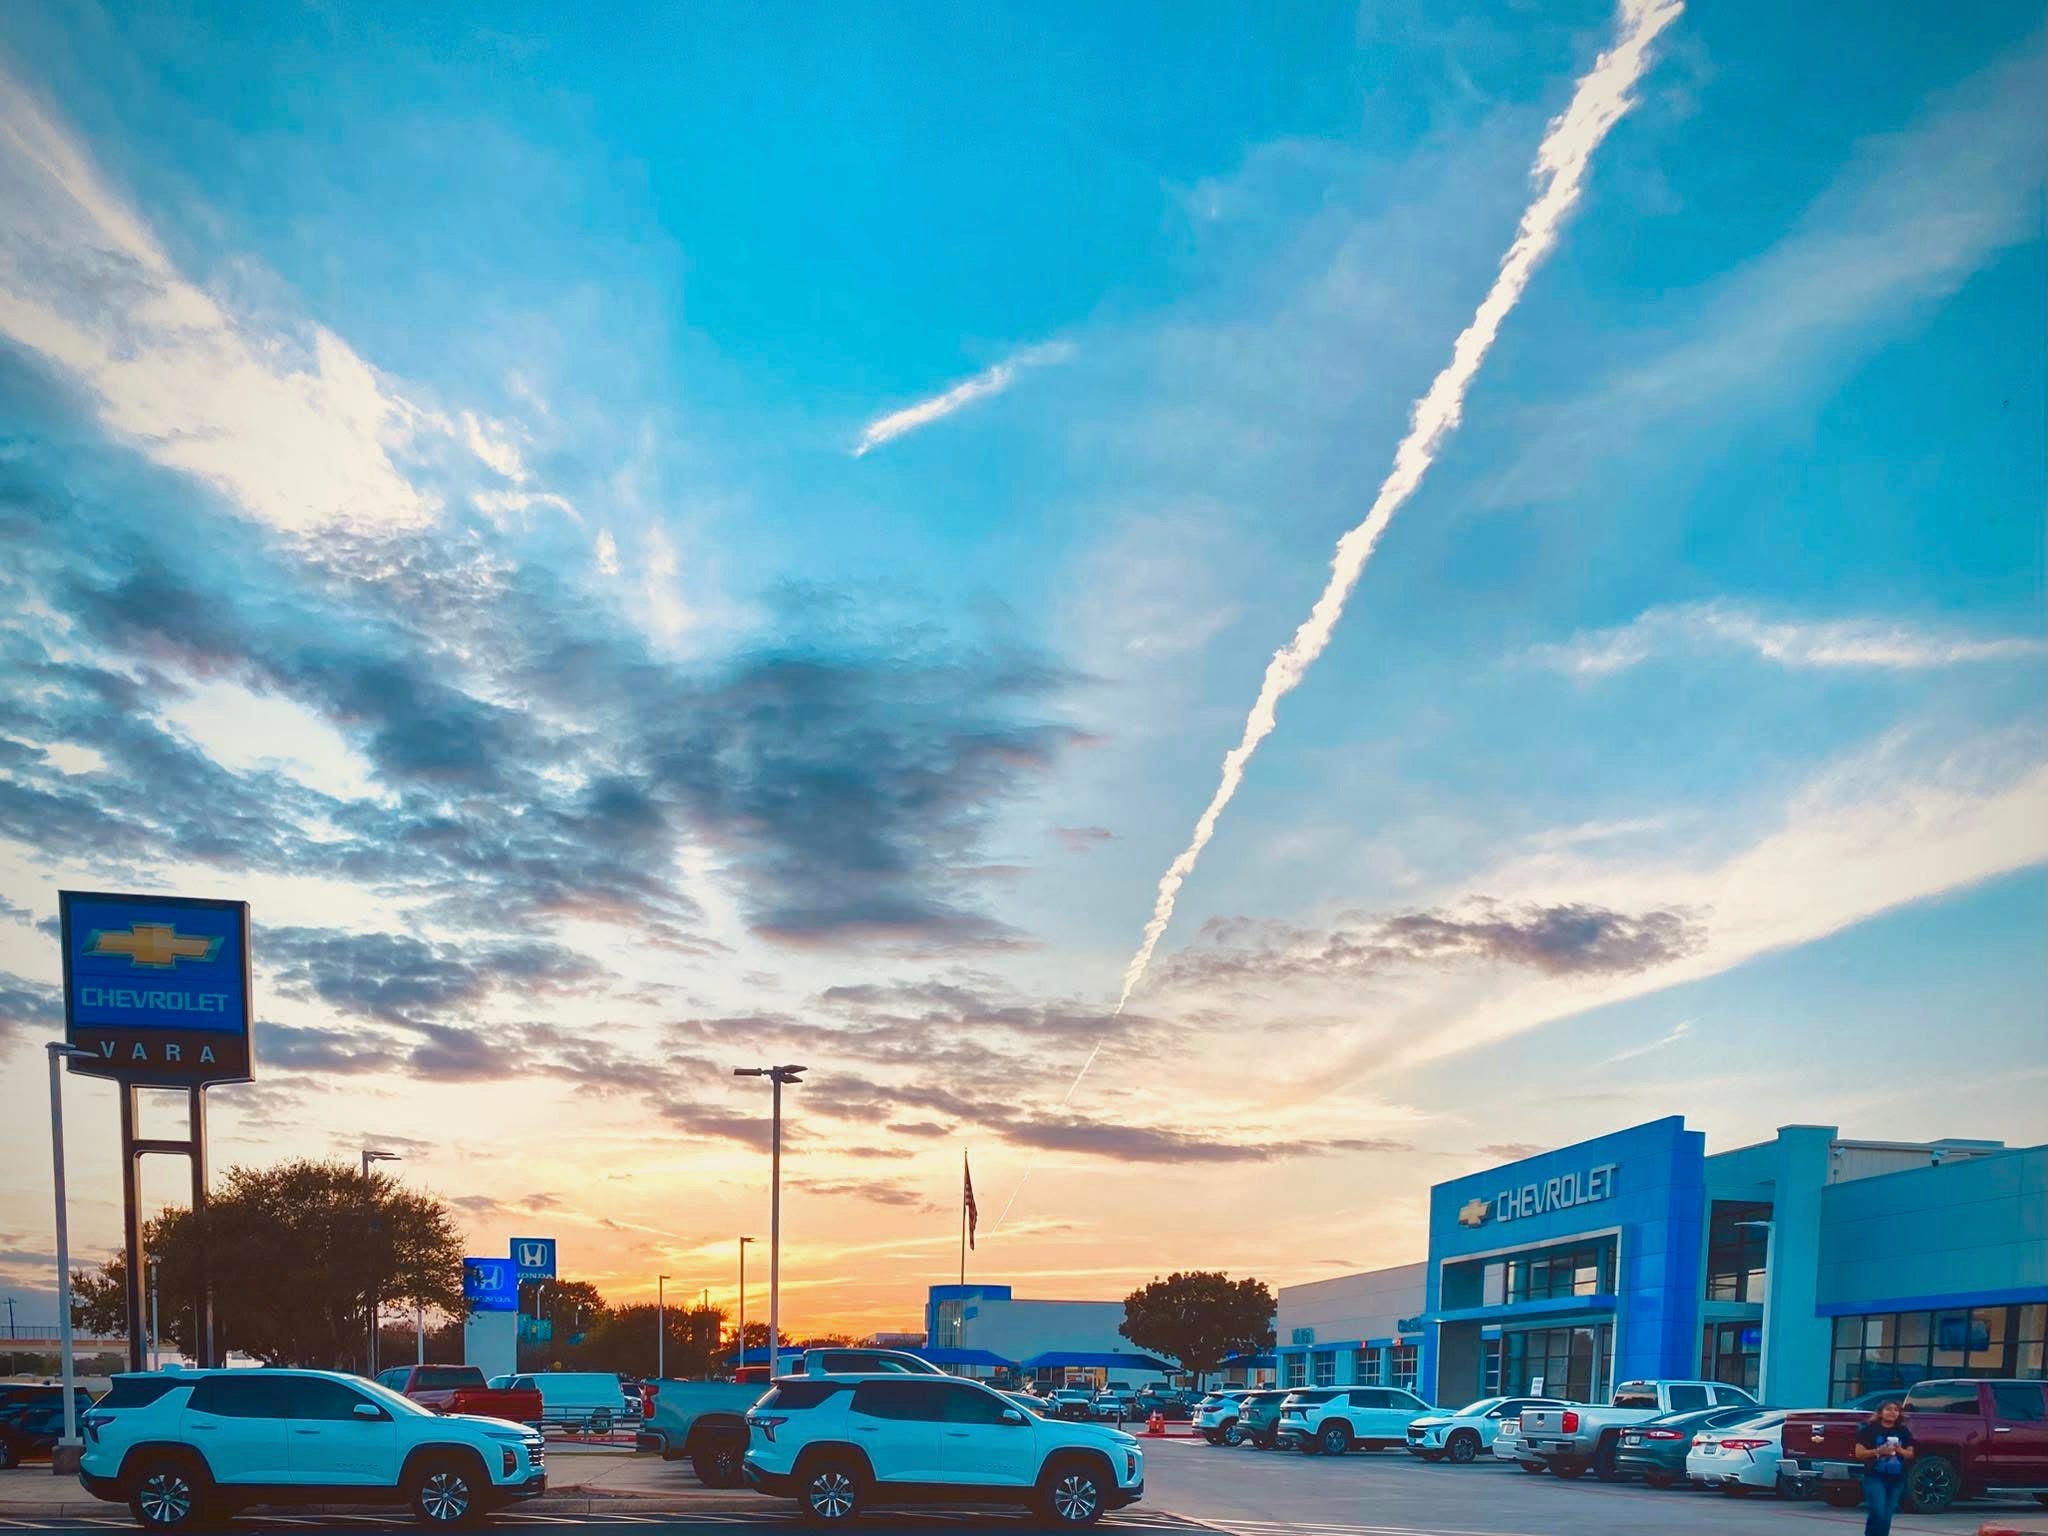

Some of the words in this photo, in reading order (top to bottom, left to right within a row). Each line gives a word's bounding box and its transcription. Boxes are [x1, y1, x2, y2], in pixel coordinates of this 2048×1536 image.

[81, 987, 228, 1012] CHEVROLET
[100, 1040, 216, 1064] VARA
[1497, 1163, 1617, 1222] CHEVROLET
[466, 1295, 512, 1303] ONDA
